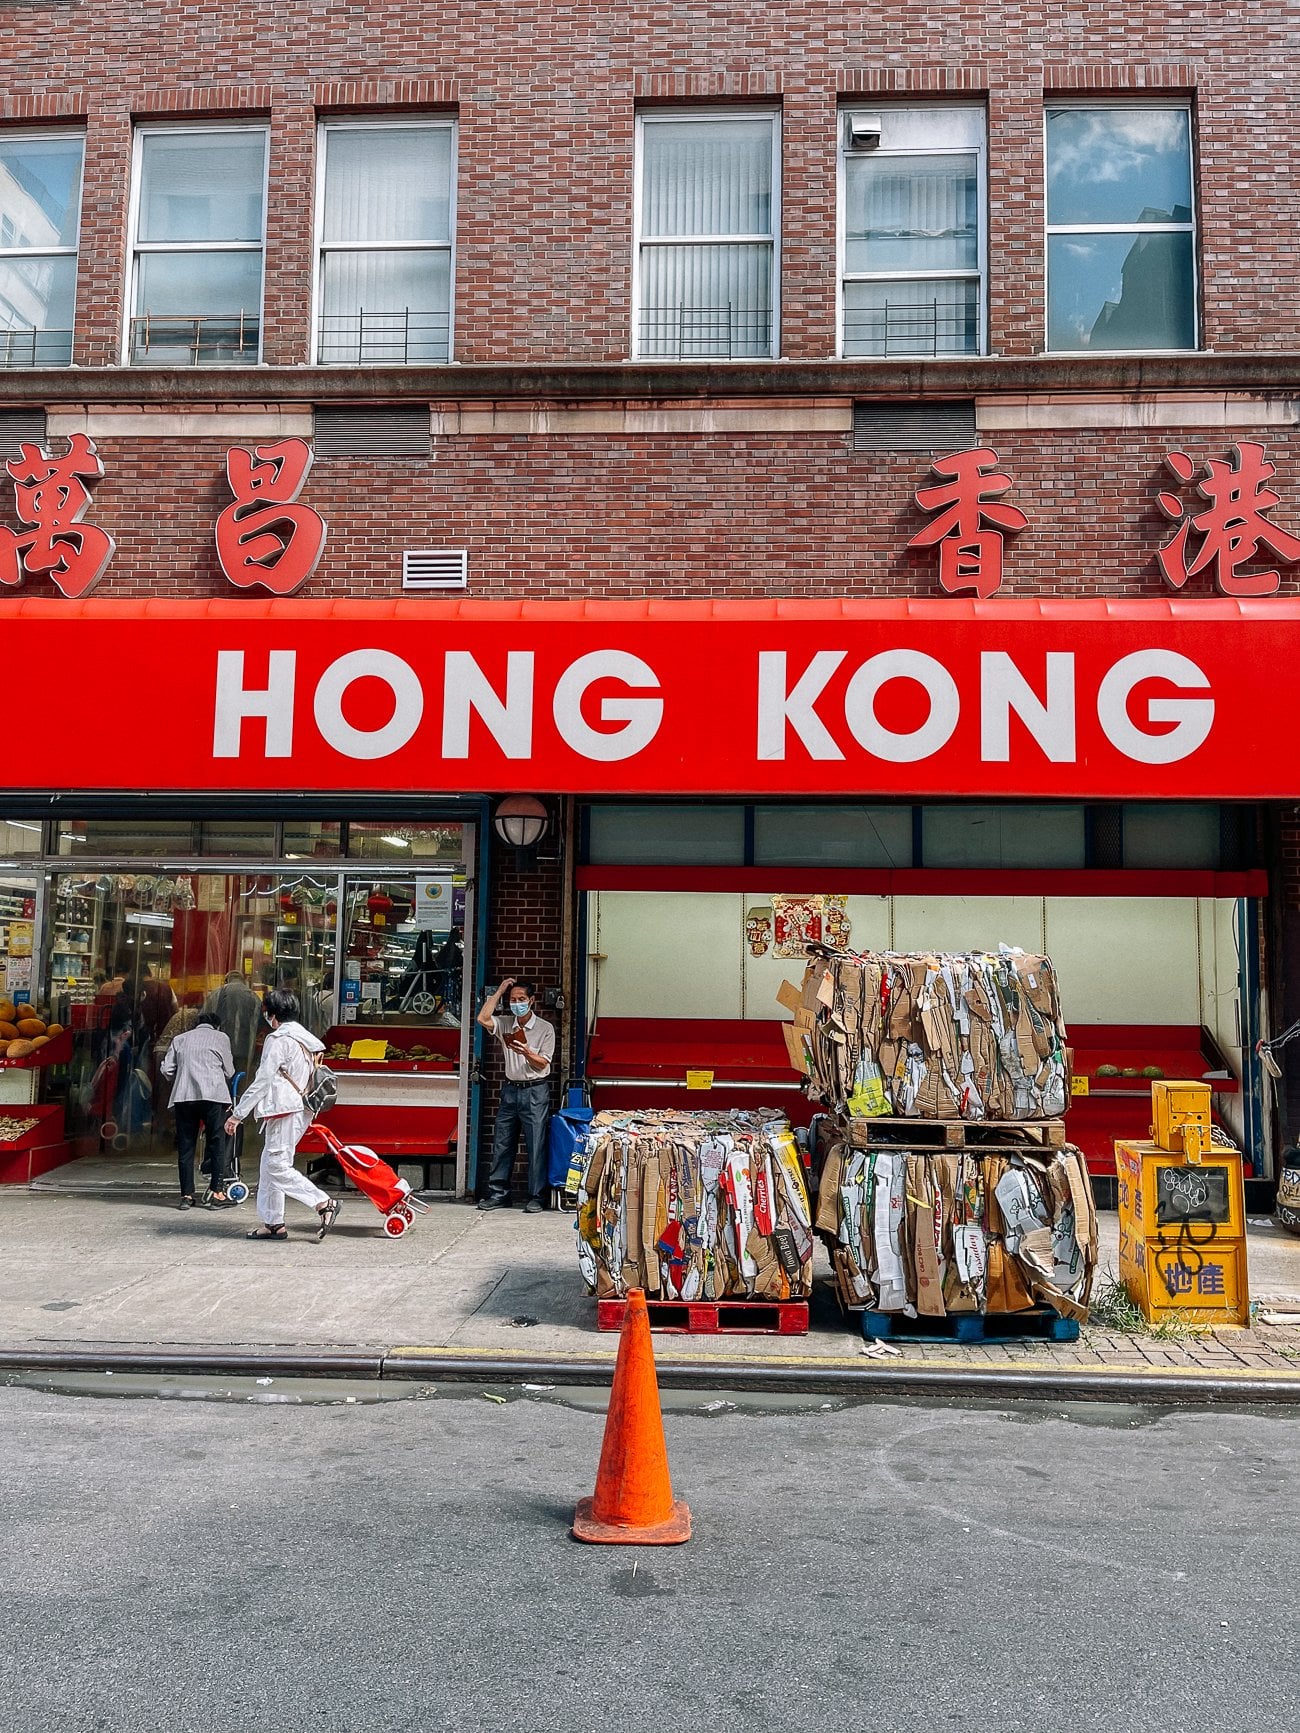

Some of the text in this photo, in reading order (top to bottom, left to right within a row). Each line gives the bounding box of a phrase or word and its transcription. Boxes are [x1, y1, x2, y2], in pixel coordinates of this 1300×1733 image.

[213, 648, 1215, 765] HONG KONG
[757, 1180, 767, 1214] Cherries
[776, 1234, 790, 1250] Beef
[784, 1250, 796, 1268] Iowa
[1164, 1262, 1226, 1295] 地產
